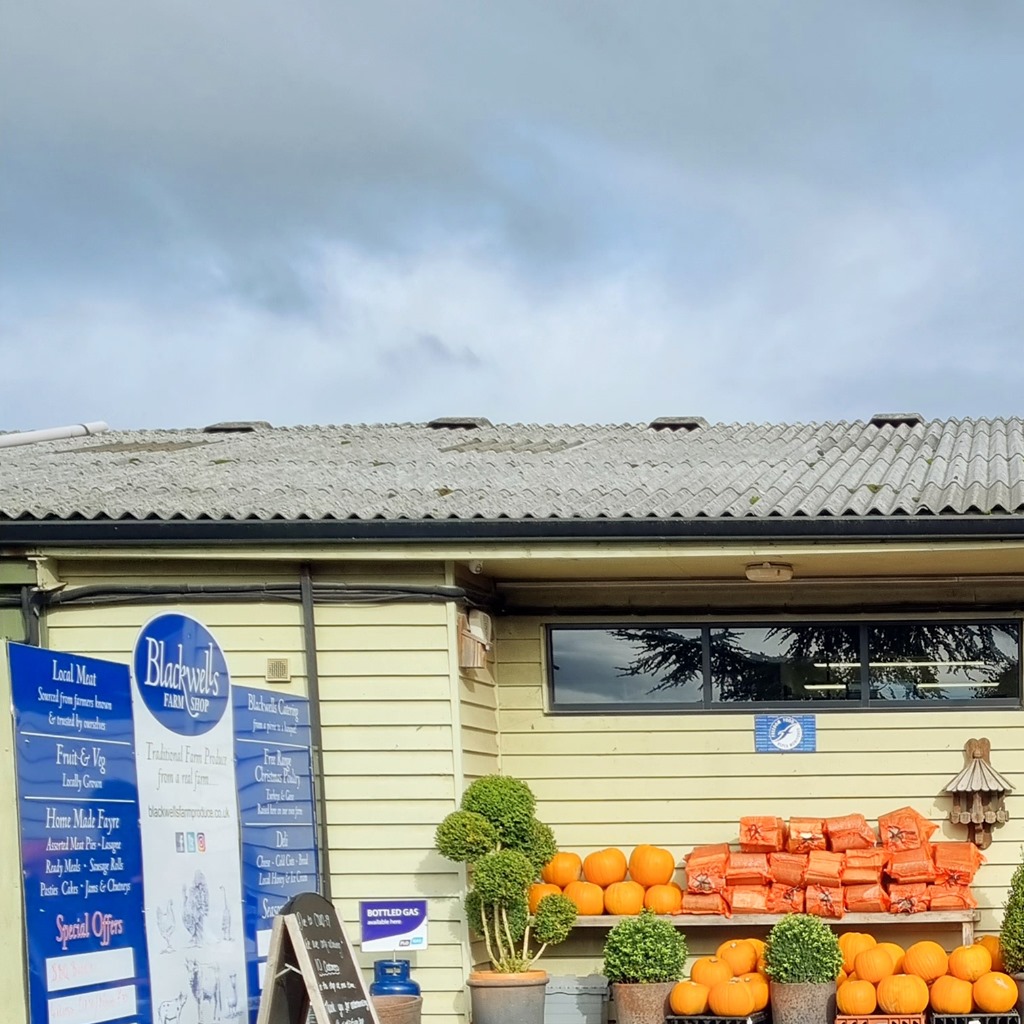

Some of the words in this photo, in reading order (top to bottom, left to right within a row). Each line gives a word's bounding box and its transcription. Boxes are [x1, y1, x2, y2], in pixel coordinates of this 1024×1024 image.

[52, 659, 74, 683] Local
[76, 664, 97, 687] Meat
[144, 636, 220, 718] Blackwells
[38, 686, 59, 704] Sourced
[59, 692, 73, 709] from
[73, 691, 94, 711] farmers
[95, 695, 112, 711] known
[163, 692, 184, 710] FARM
[191, 697, 210, 713] SHOP
[248, 693, 277, 714] Blackwells
[278, 698, 299, 723] Catering
[48, 711, 56, 725] &
[57, 713, 75, 728] trusted
[75, 714, 83, 733] by
[83, 717, 106, 731] ourselves
[56, 743, 78, 766] Fruit
[80, 747, 90, 767] &
[92, 747, 106, 774] Veg
[145, 741, 183, 762] Traditional
[185, 745, 202, 764] Farm
[204, 746, 227, 766] Produce
[263, 748, 276, 765] Free
[277, 749, 292, 771] Range
[62, 772, 82, 792] Locally
[82, 774, 103, 790] Grown
[156, 768, 173, 791] from
[175, 774, 180, 784] a
[181, 767, 193, 784] real
[254, 765, 282, 783] Christmas
[282, 767, 300, 790] Poultry
[46, 807, 71, 829] Home
[73, 808, 96, 829] Made
[97, 808, 121, 835] Fayre
[148, 805, 230, 821] blackwellsfarmproduce.co.uk
[46, 836, 69, 852] Assorted
[69, 837, 85, 851] Meat
[85, 837, 97, 850] Pies
[101, 837, 121, 854] Lasagne
[276, 830, 289, 848] Deli
[45, 859, 63, 878] Ready
[64, 859, 81, 873] Meals
[89, 857, 109, 876] Sausage
[110, 857, 124, 872] Rolls
[256, 854, 271, 868] Cheese
[40, 881, 58, 897] Pasties
[61, 881, 79, 895] Cakes
[84, 879, 99, 899] Jams
[99, 879, 107, 891] &
[107, 878, 131, 896] Chutneys
[258, 872, 271, 886] Local
[271, 871, 285, 888] Honey
[296, 870, 308, 883] Cream
[366, 908, 402, 917] BOTTLED
[402, 908, 419, 916] GAS
[56, 912, 89, 950] Special
[91, 910, 123, 947] Offers
